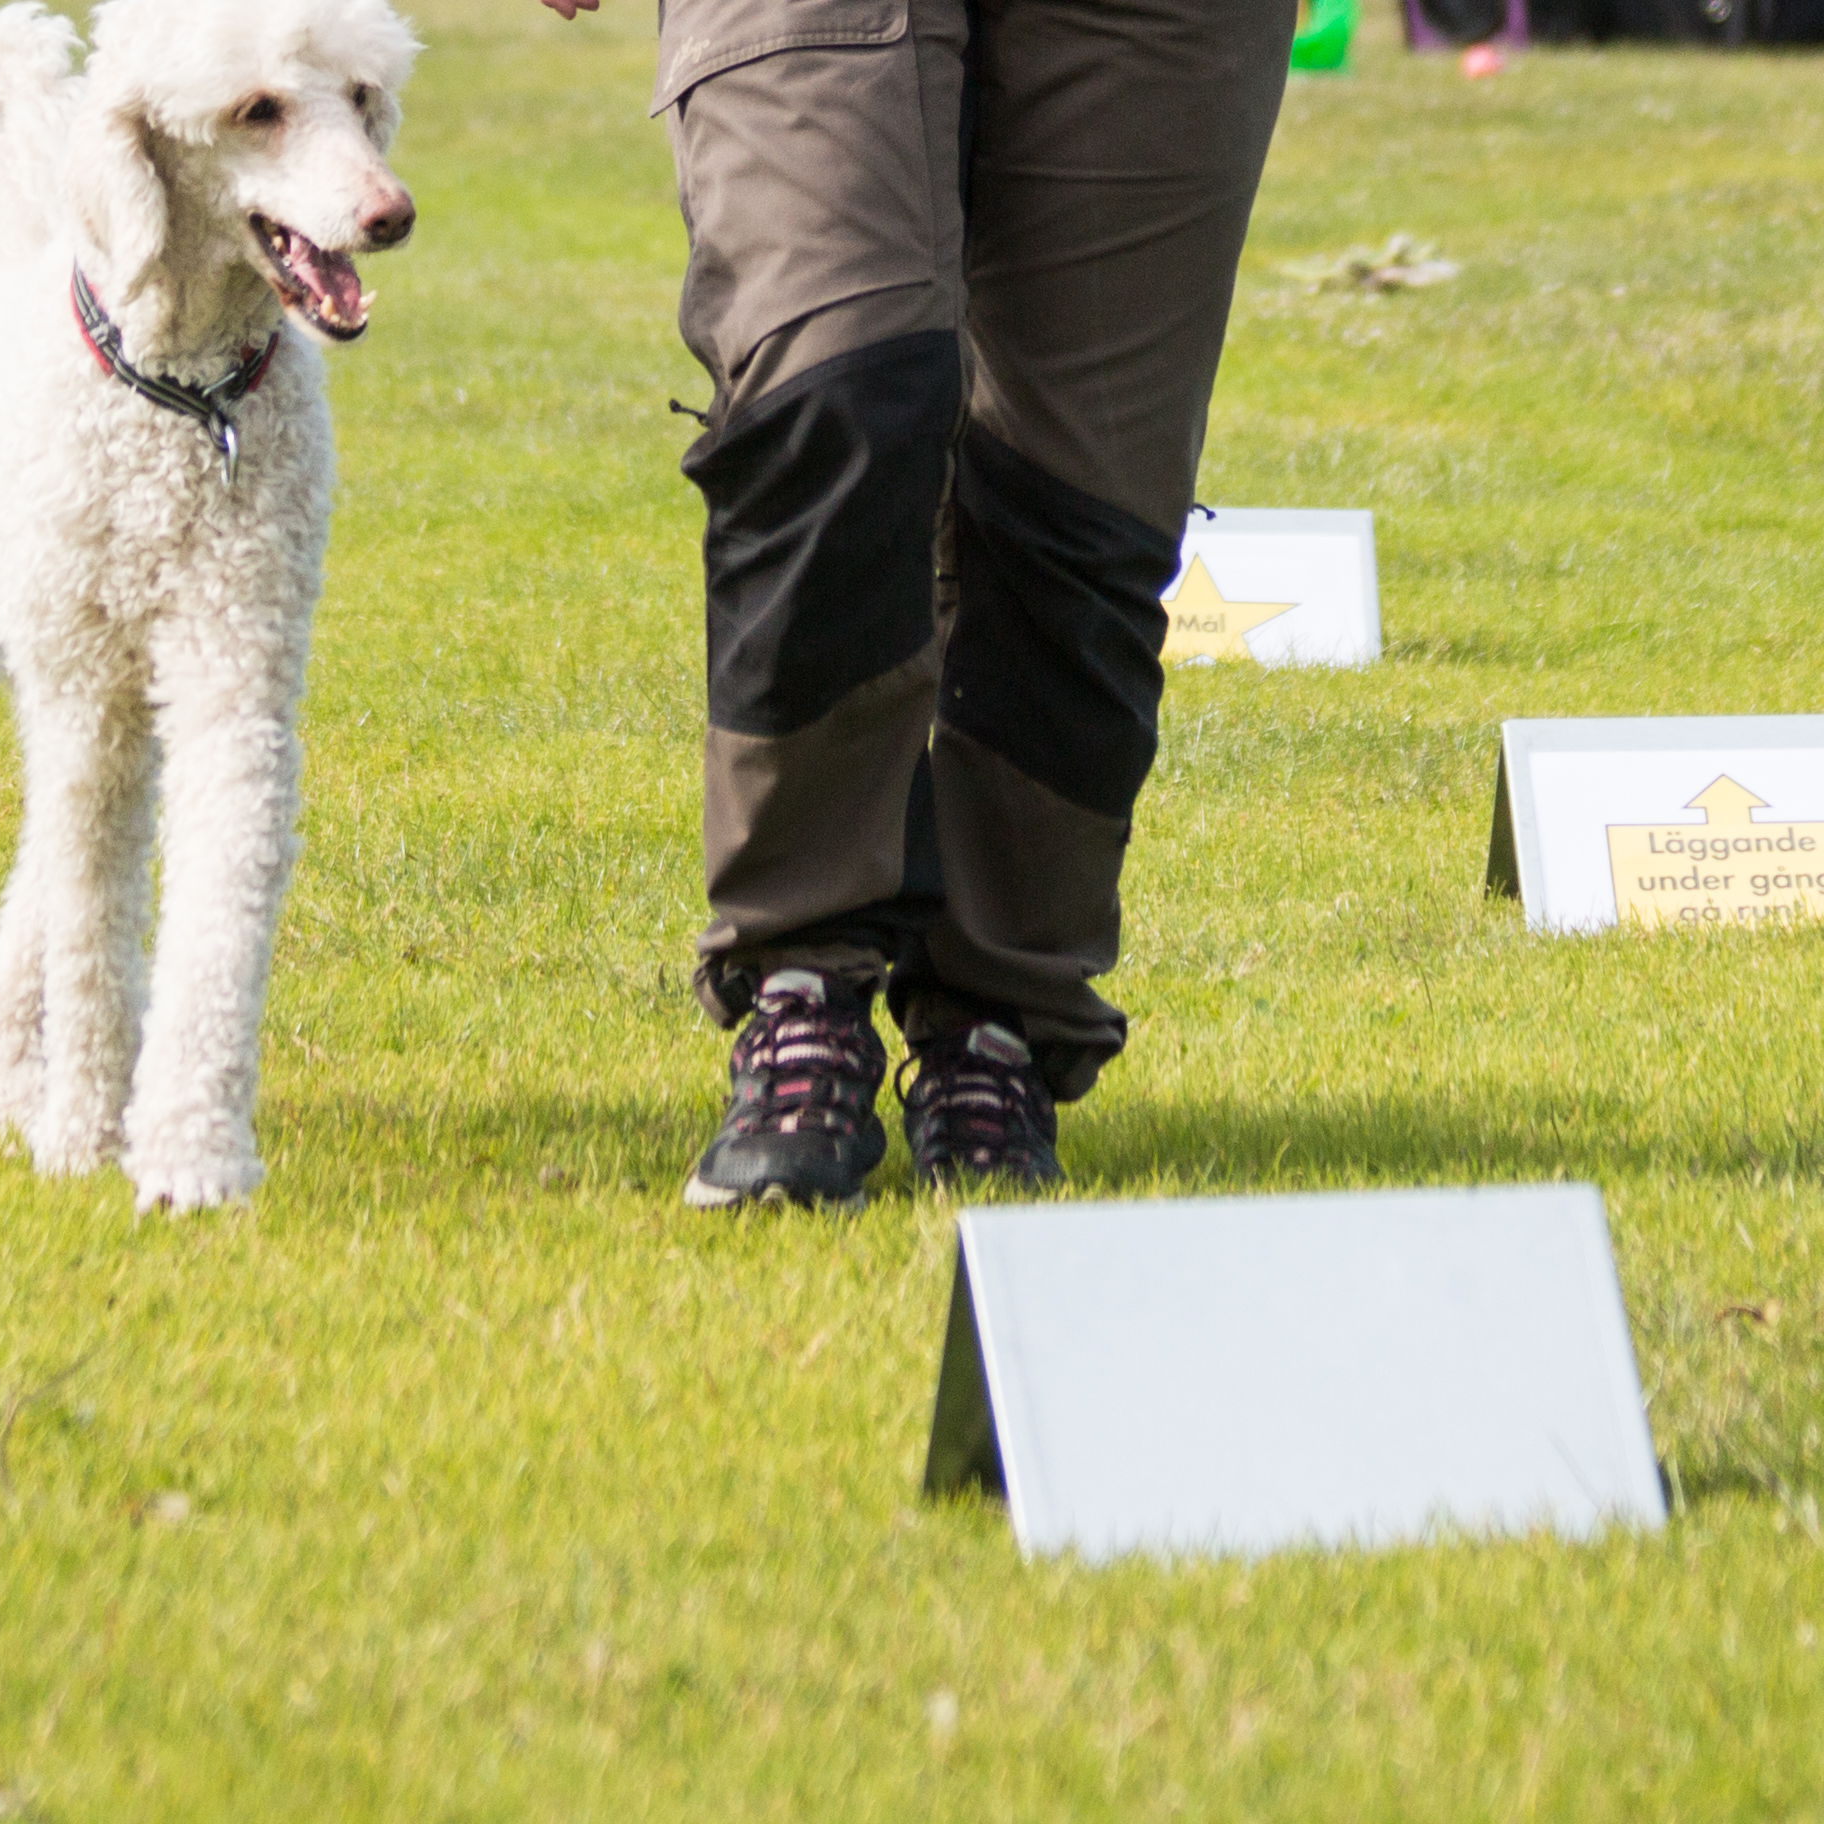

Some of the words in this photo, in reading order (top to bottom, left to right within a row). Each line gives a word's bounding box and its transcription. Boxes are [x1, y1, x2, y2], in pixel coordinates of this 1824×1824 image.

[1176, 613, 1225, 633] Mål
[1648, 827, 1817, 861] Läggande
[1637, 865, 1735, 892] under
